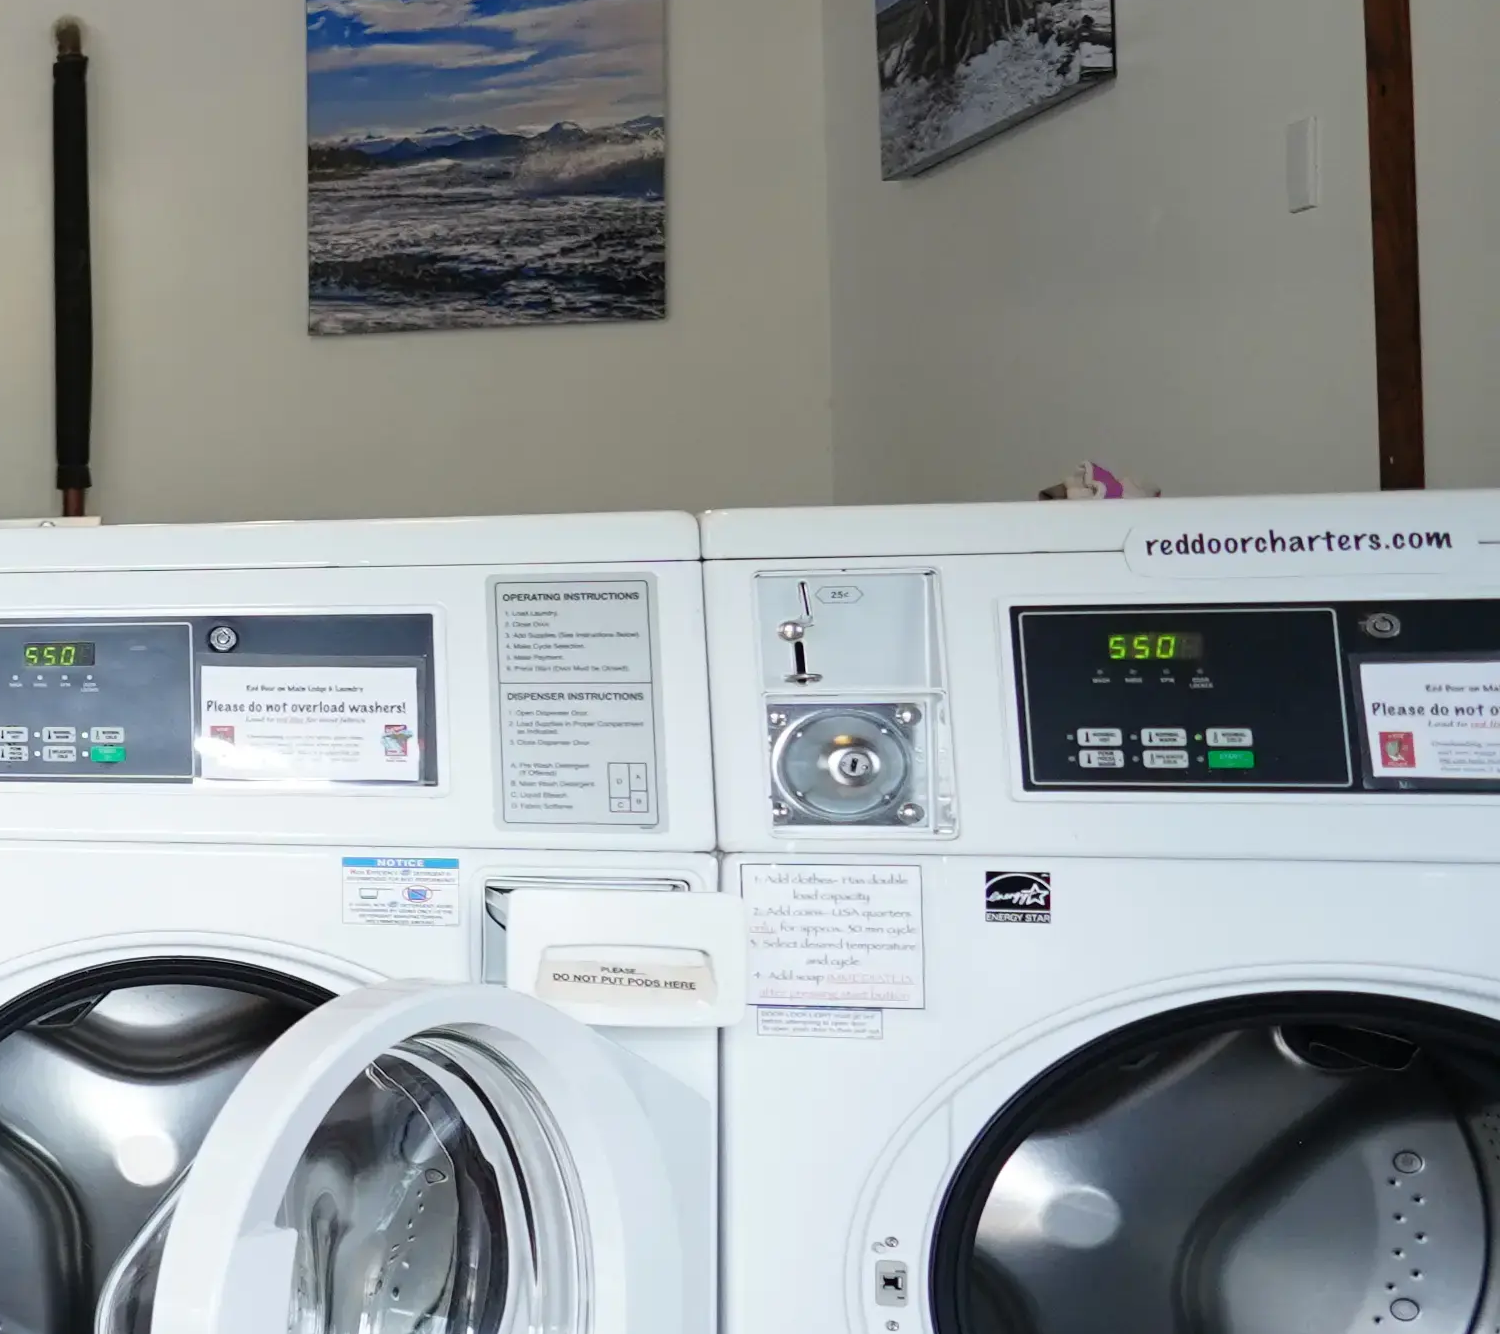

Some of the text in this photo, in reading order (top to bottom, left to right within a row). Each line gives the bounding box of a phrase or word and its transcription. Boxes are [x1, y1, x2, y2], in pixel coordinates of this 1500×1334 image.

[1145, 529, 1453, 556] reddoorcharters.com
[503, 592, 639, 601] OPERATING INSTRUCTIONS
[1108, 635, 1176, 660] 550
[207, 700, 406, 714] Please do not overload washers!
[1372, 703, 1425, 716] Please
[1431, 703, 1449, 716] do
[1455, 704, 1484, 716] not
[376, 859, 424, 867] NOTICE
[765, 874, 789, 884] Add
[867, 874, 908, 884] double
[793, 889, 870, 904] load capacity
[766, 906, 791, 916] Add
[832, 909, 859, 917] USA
[862, 909, 912, 920] quarters
[987, 913, 1050, 922] ENERGY STAR
[780, 921, 796, 932] for
[763, 939, 798, 949] Select
[846, 941, 916, 955] temperature
[806, 954, 860, 970] and cycle
[600, 966, 636, 974] PLEASE
[553, 973, 696, 990] DO NOT PUT PODS HERE
[768, 971, 824, 985] Add soap
